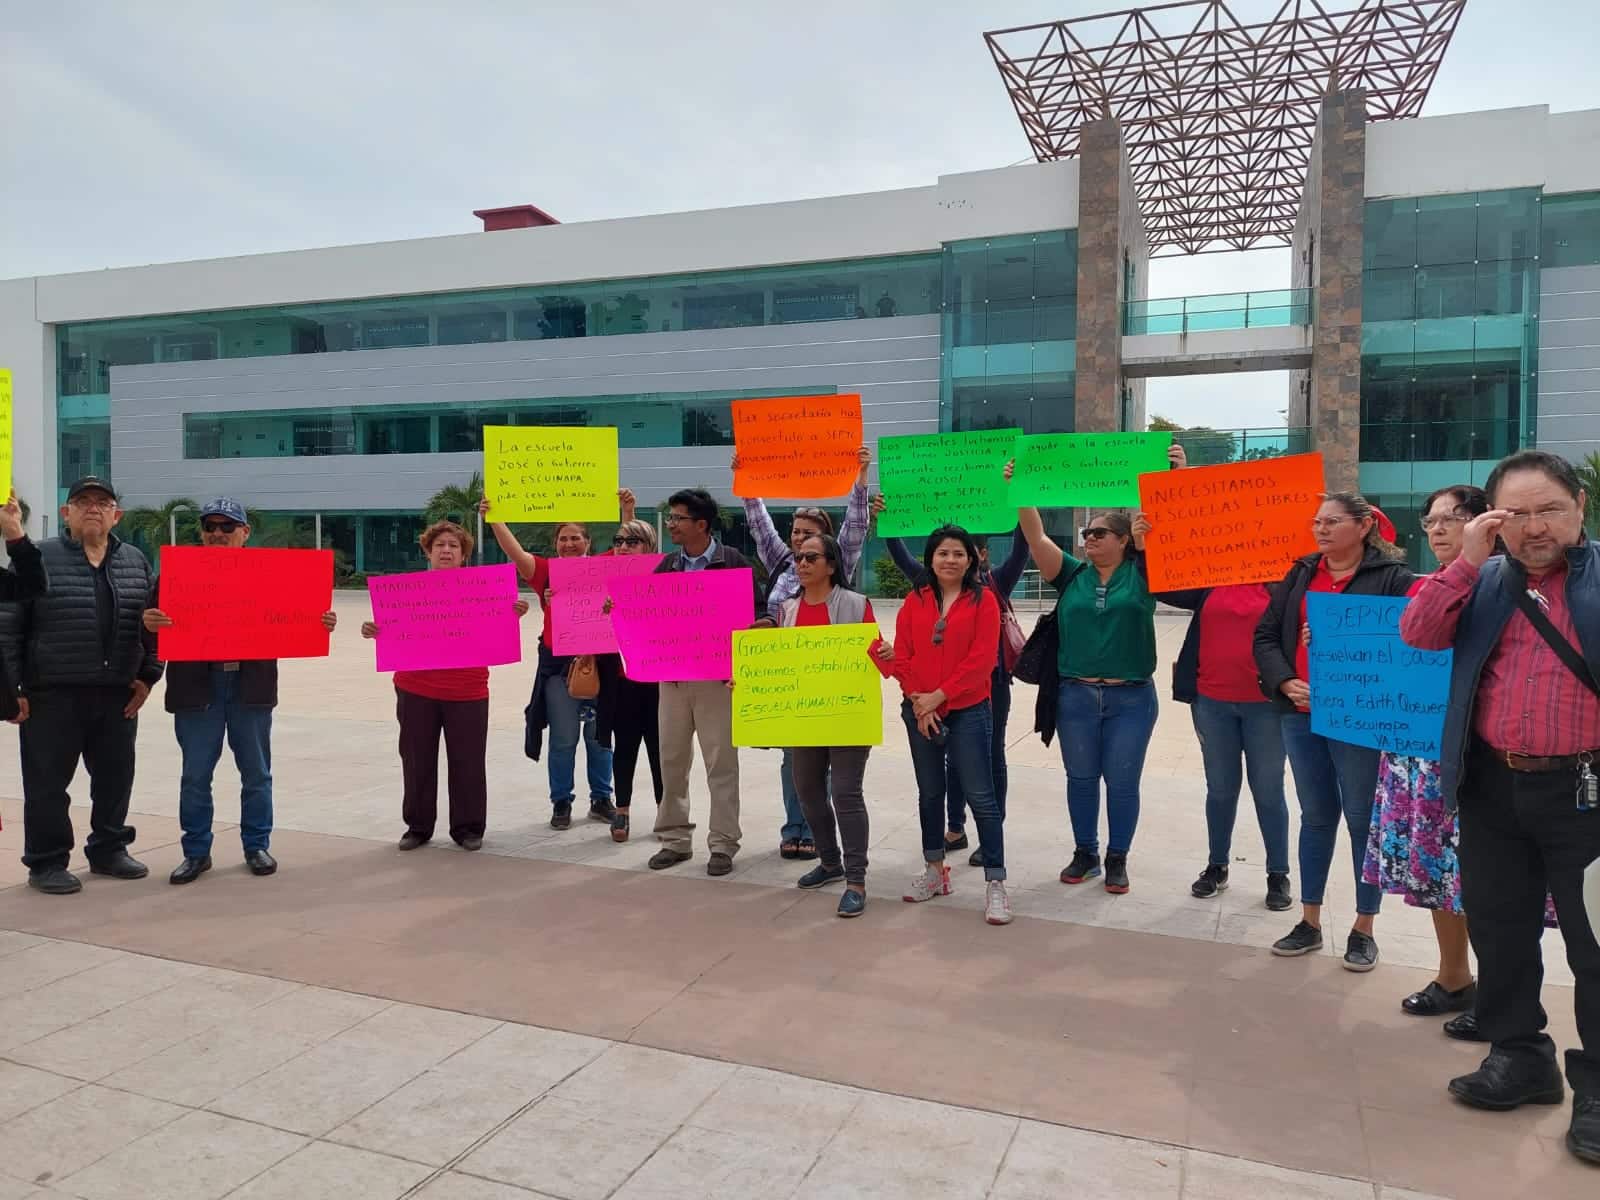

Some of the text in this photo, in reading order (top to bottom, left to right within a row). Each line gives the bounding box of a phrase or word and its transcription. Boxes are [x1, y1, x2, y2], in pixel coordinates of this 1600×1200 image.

[499, 439, 574, 454] La escuela
[880, 440, 900, 450] Los
[908, 436, 958, 449] docentes
[1085, 438, 1096, 448] la
[536, 458, 544, 468] G
[1062, 460, 1072, 469] G
[499, 474, 584, 488] de ESCUINAPA
[1063, 479, 1130, 489] ESCUINAPA
[523, 502, 555, 513] laboral
[1154, 492, 1310, 522] ESCUELAS LIBRES
[1159, 531, 1177, 545] DE
[1189, 521, 1246, 541] ACOSO
